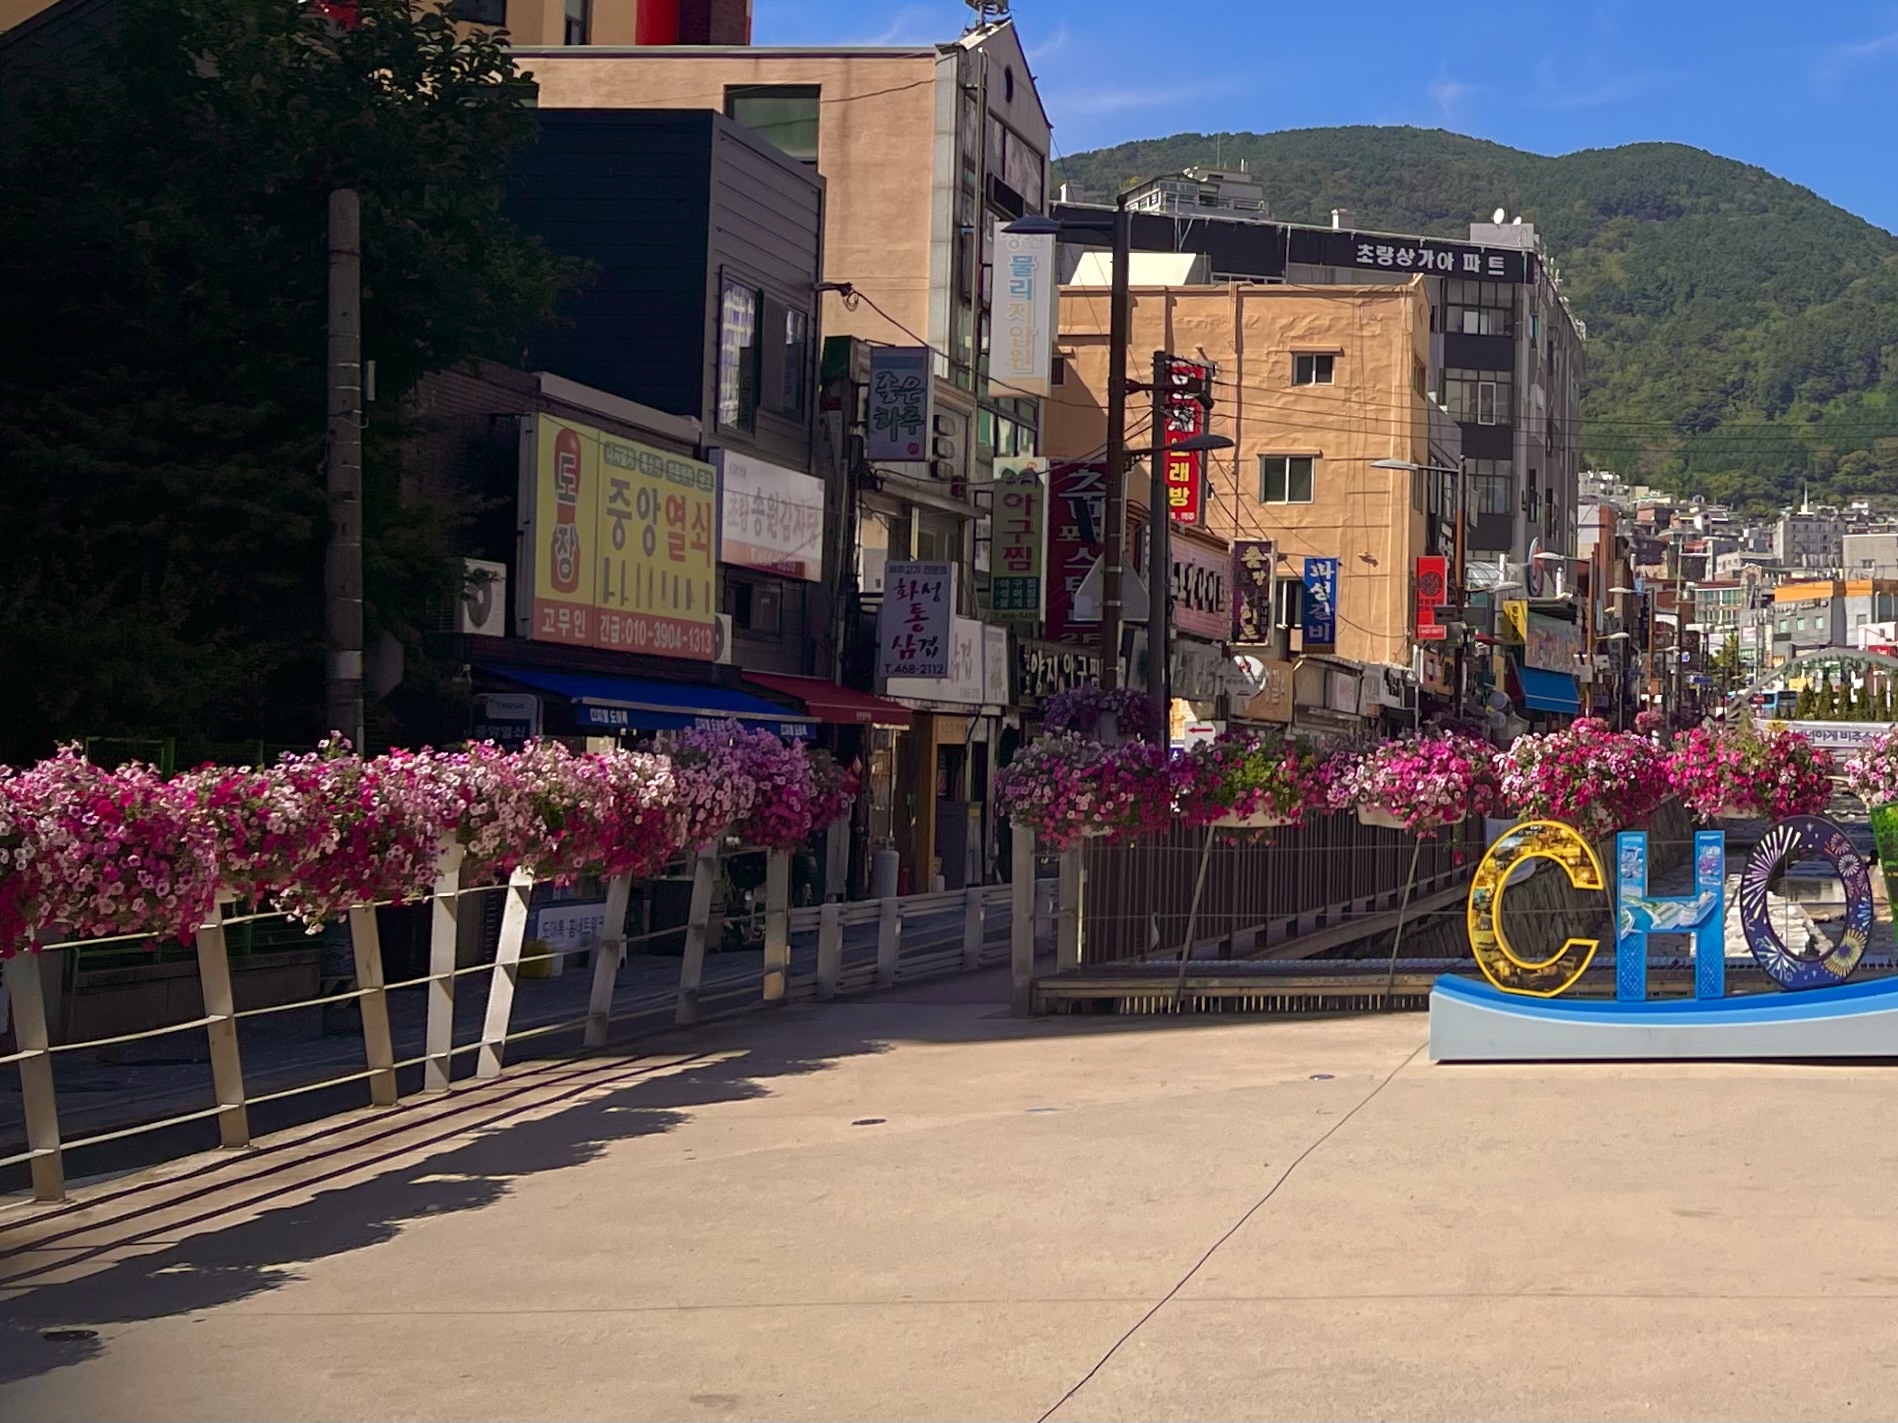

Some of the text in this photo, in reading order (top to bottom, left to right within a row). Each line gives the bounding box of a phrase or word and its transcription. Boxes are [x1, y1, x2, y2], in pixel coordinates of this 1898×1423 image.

[875, 371, 925, 404] 좋은
[873, 406, 925, 443] 하루
[554, 452, 580, 582] 도장
[606, 477, 712, 569] 중앙열쇠
[1003, 492, 1037, 571] 아구찜
[542, 608, 586, 638] 고무인
